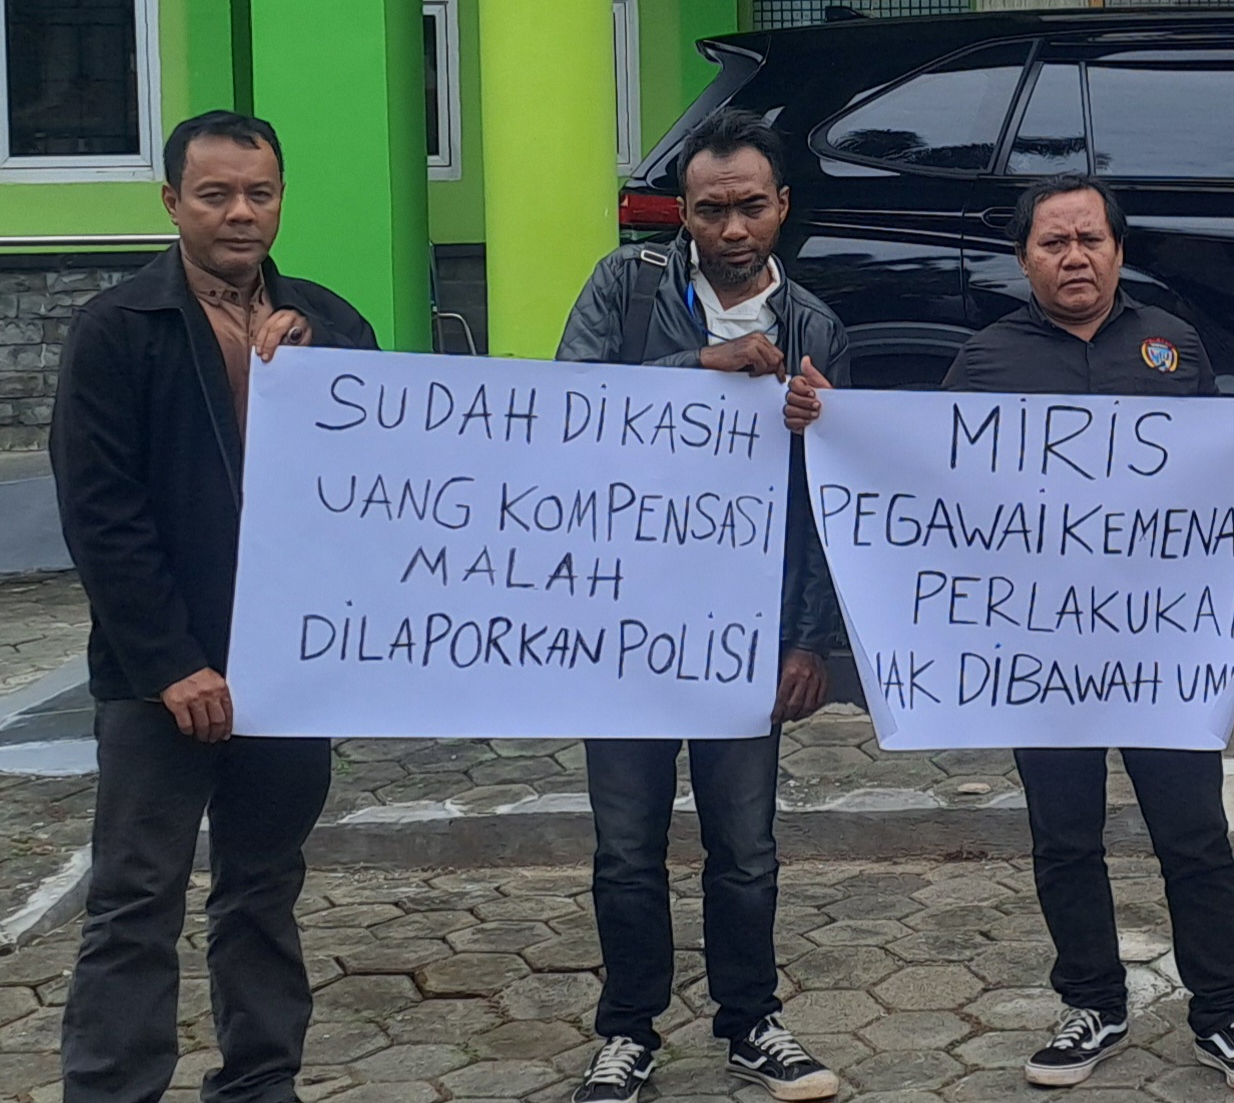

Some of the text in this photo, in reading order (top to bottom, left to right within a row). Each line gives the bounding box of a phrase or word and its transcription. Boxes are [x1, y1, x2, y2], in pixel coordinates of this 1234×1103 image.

[315, 374, 538, 445] SUDAH
[950, 398, 1173, 480] MIRIS
[317, 474, 774, 554] UANG KOMPENSASI
[400, 545, 624, 601] MALAH
[300, 600, 763, 683] DILAPORKAN POLISI
[876, 650, 942, 710] AK
